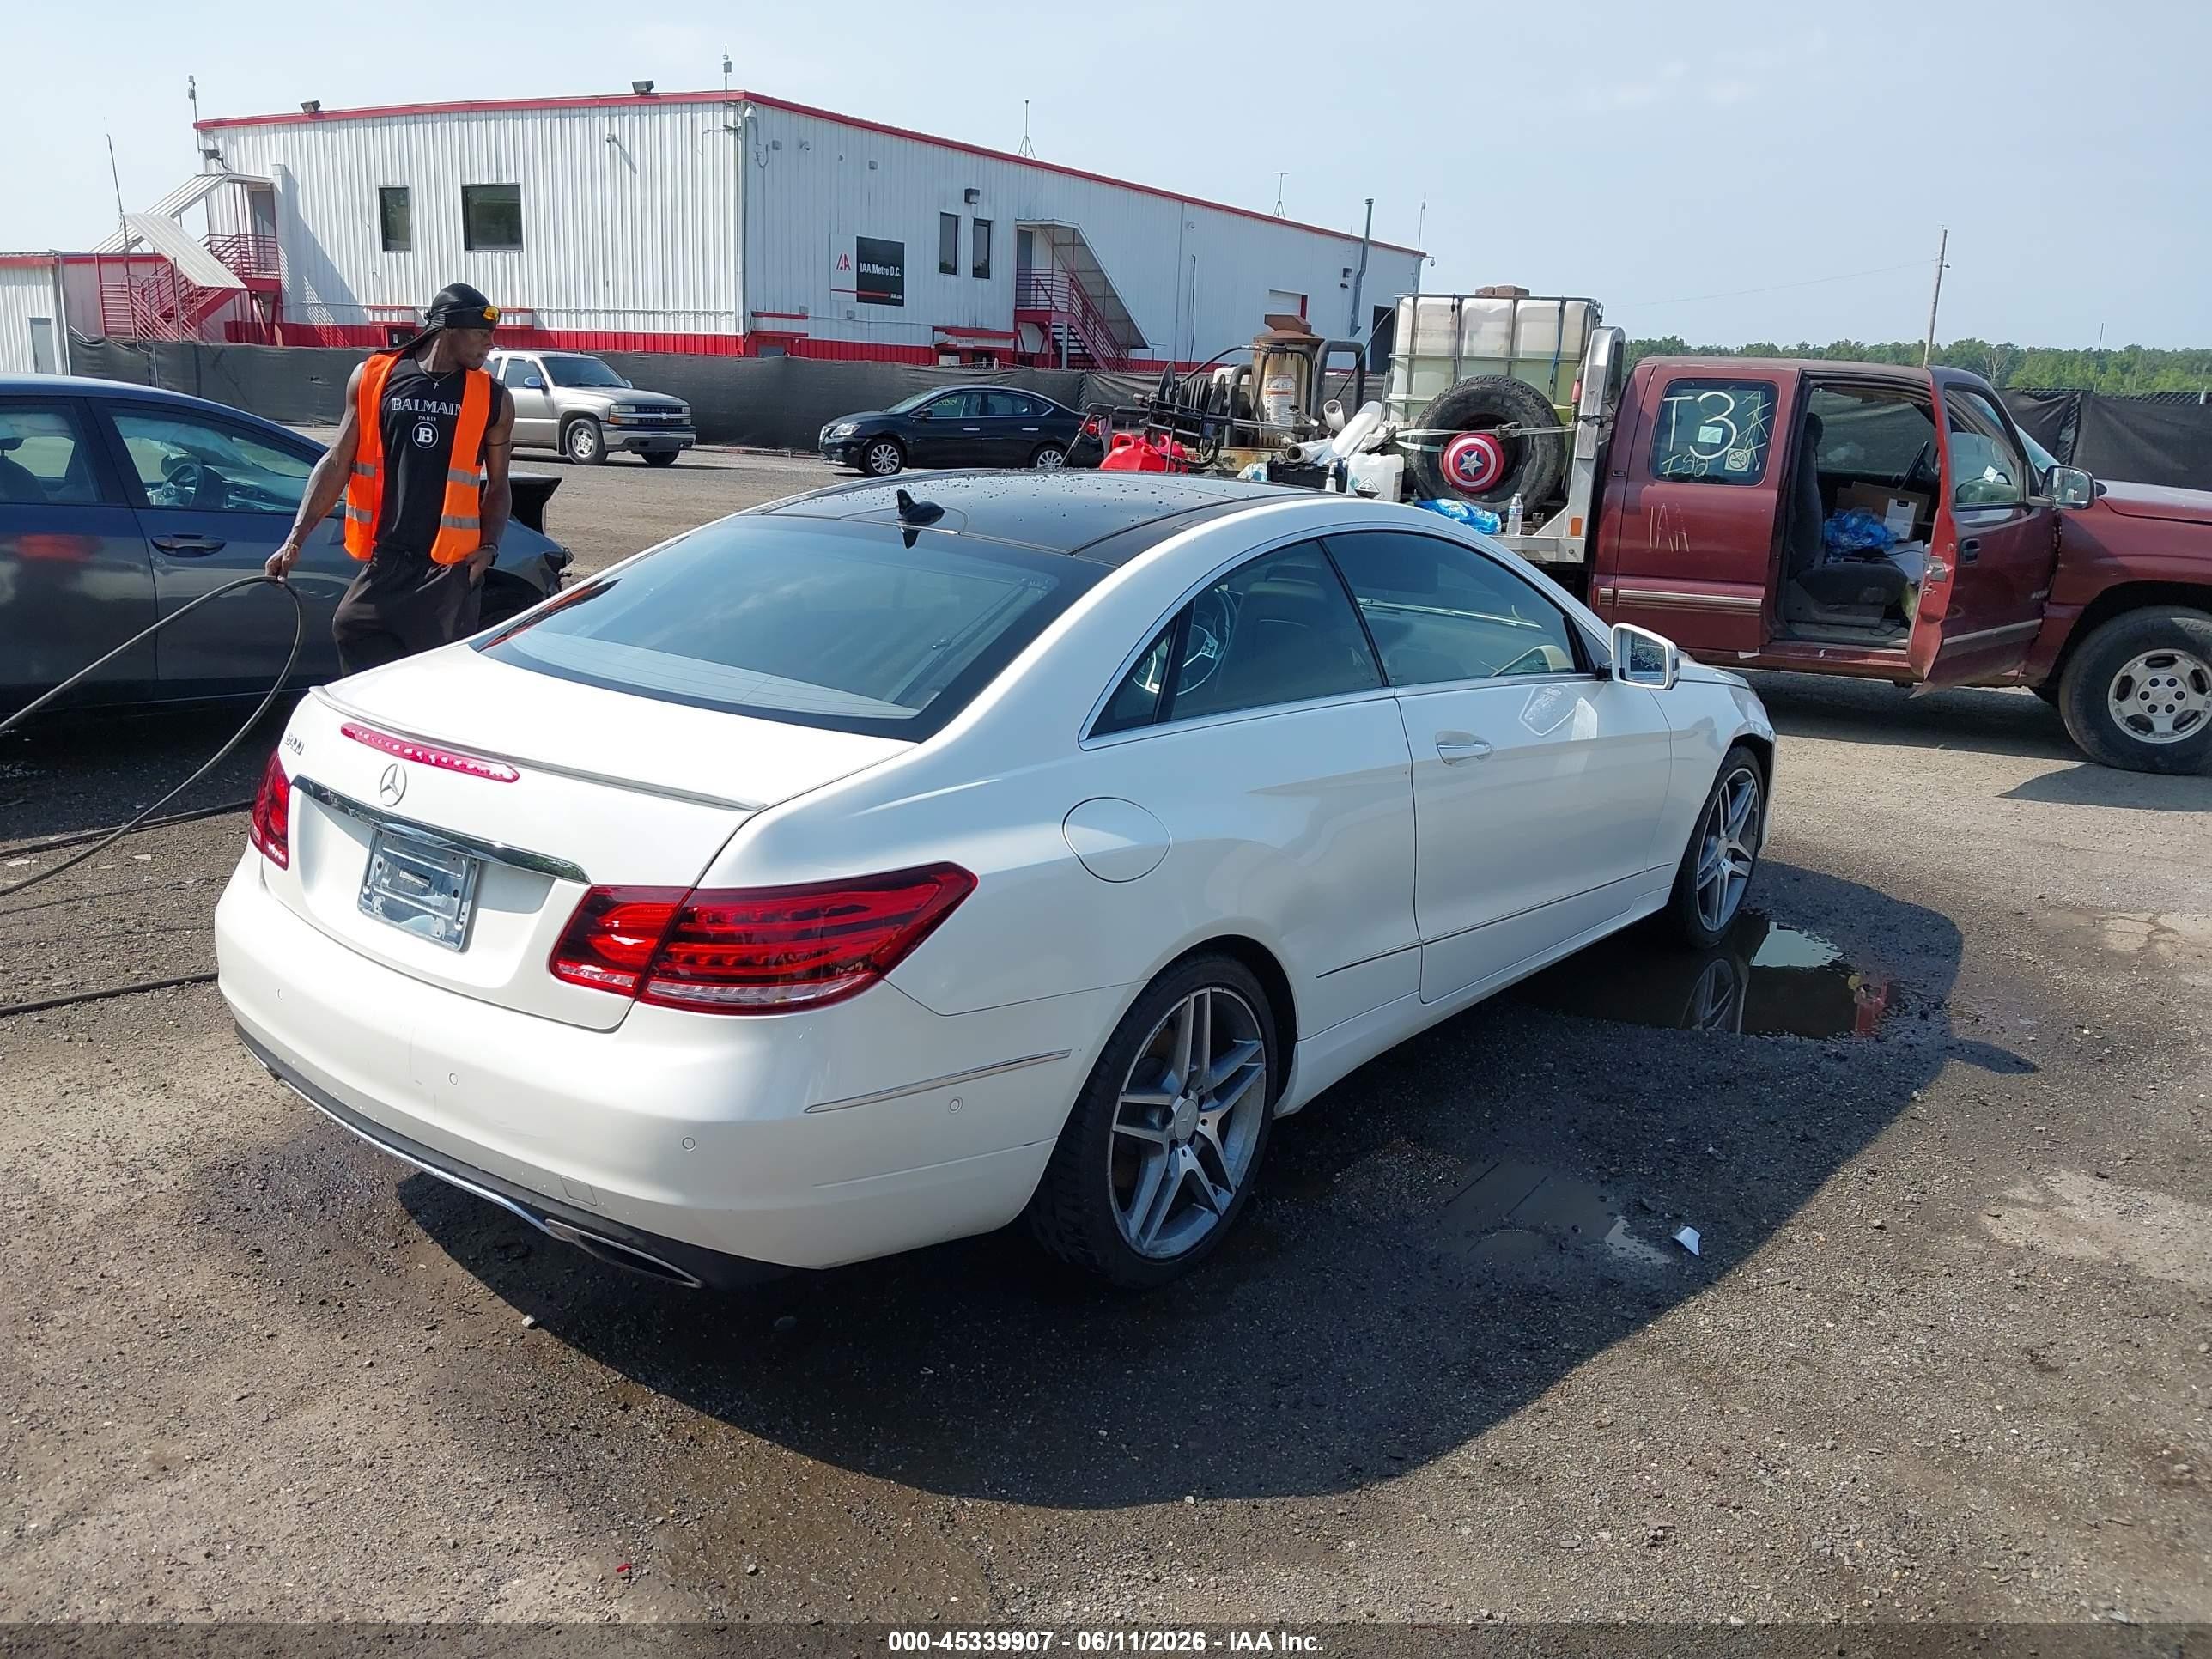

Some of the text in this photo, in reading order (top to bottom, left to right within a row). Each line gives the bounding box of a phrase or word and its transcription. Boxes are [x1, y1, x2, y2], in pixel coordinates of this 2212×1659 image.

[860, 262, 902, 276] IAA Metro D.C.
[1663, 391, 1737, 459] T3
